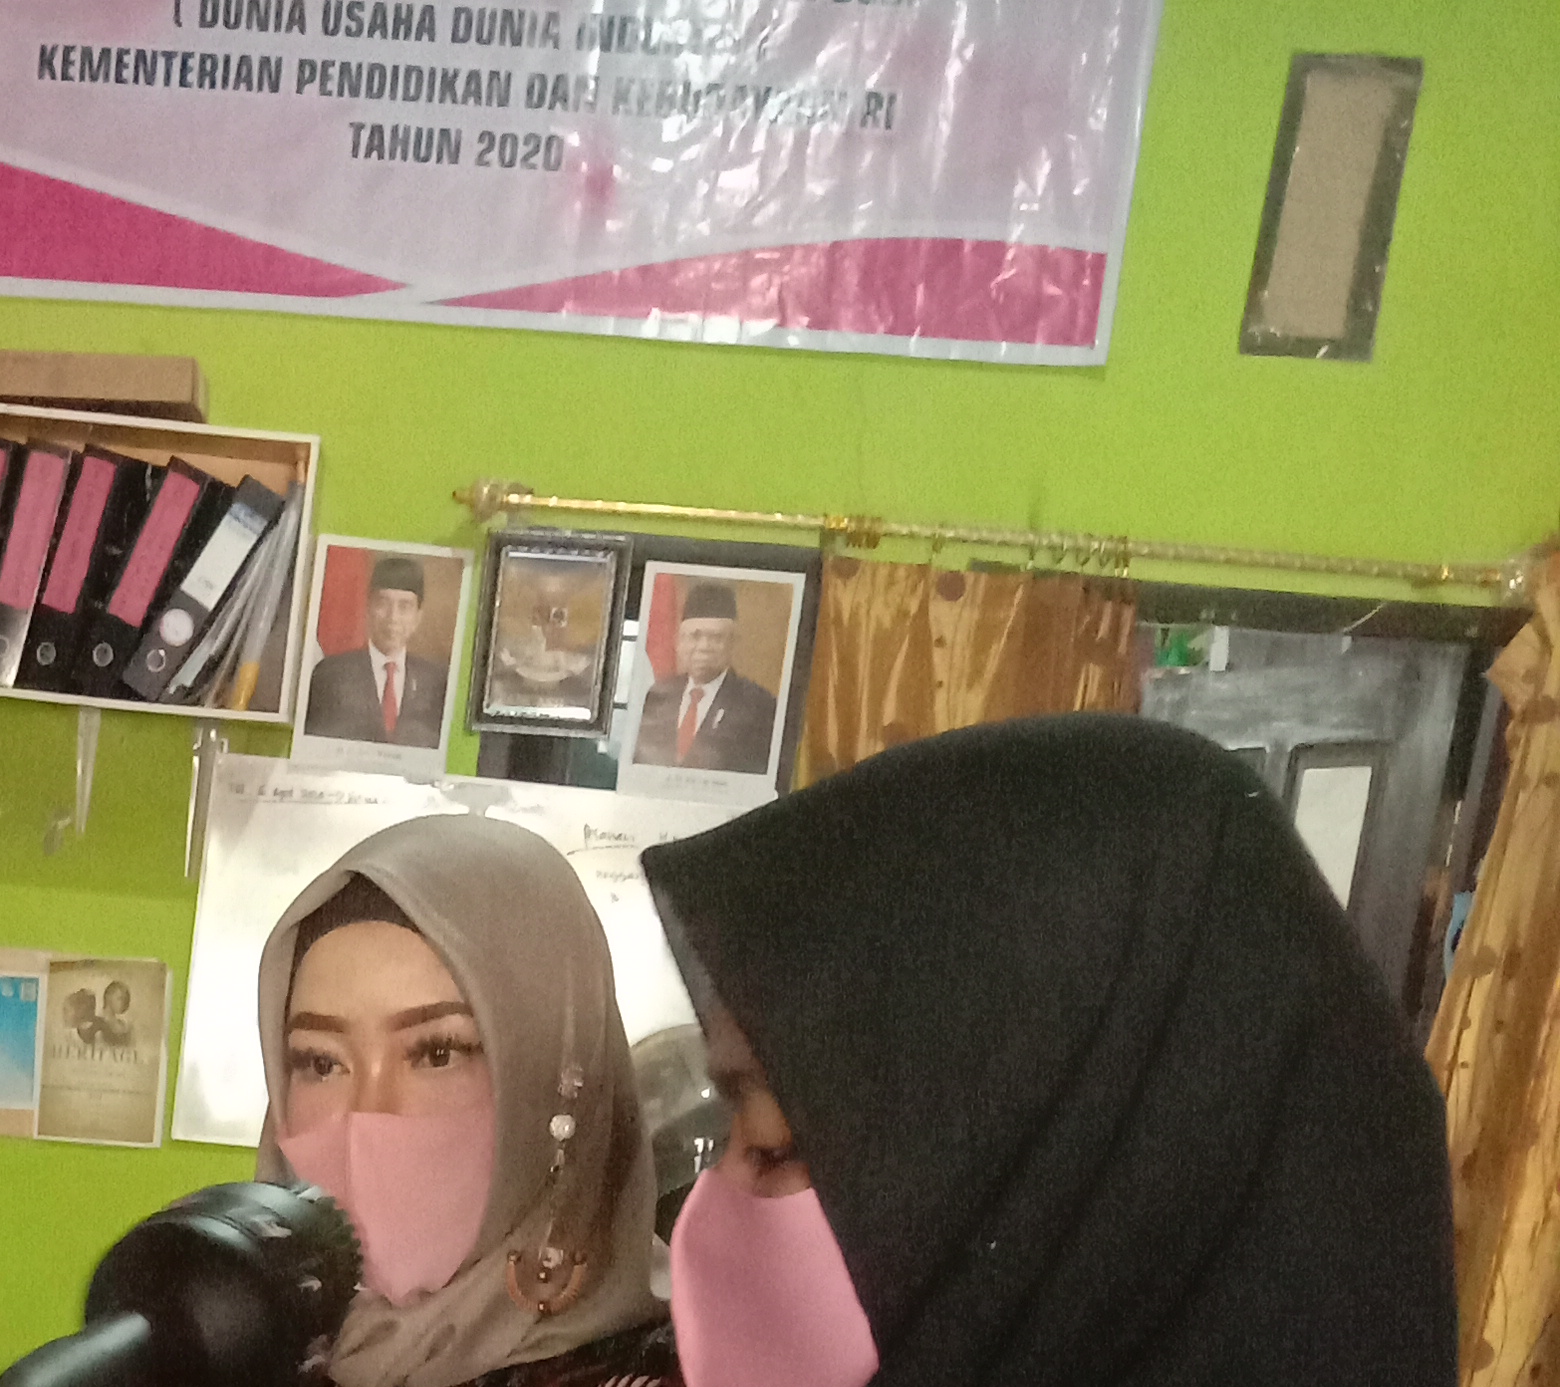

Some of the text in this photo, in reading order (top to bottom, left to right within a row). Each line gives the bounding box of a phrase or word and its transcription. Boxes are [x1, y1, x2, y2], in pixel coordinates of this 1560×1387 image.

[198, 0, 307, 36] DUNIA
[321, 2, 436, 43] USAHA
[450, 6, 561, 50] DUNIA
[37, 43, 283, 94] KEMENTERIAN
[295, 58, 512, 108] PENDIDIKAN
[525, 72, 600, 113] DAN
[859, 89, 898, 130] RI
[348, 121, 566, 172] TAHUN 2020
